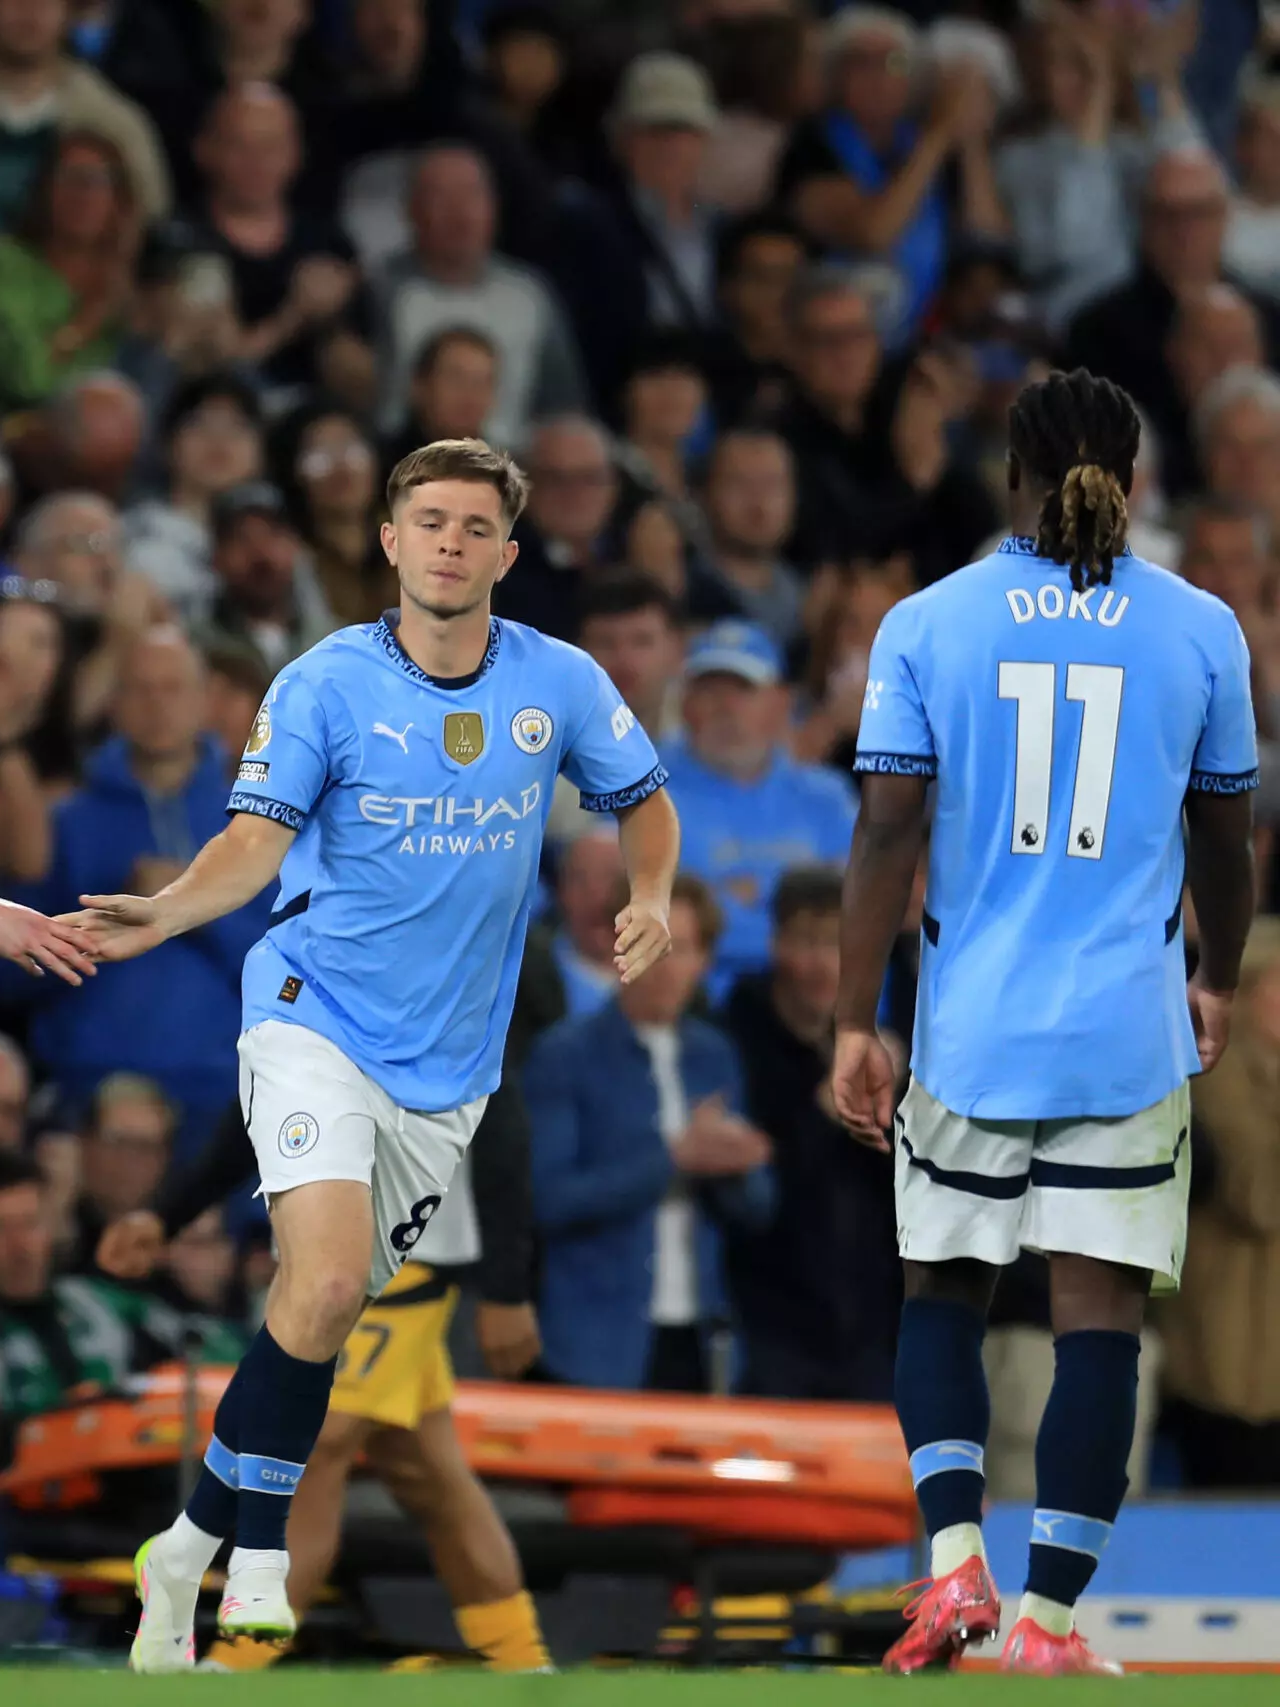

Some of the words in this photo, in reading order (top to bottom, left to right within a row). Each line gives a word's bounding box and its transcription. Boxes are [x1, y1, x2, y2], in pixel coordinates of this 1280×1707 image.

[1005, 584, 1130, 627] DOKU
[455, 746, 474, 754] FIFA
[997, 661, 1125, 860] 11
[359, 781, 540, 827] ETIHAD
[398, 830, 516, 855] AIRWAYS
[390, 1194, 442, 1251] 8
